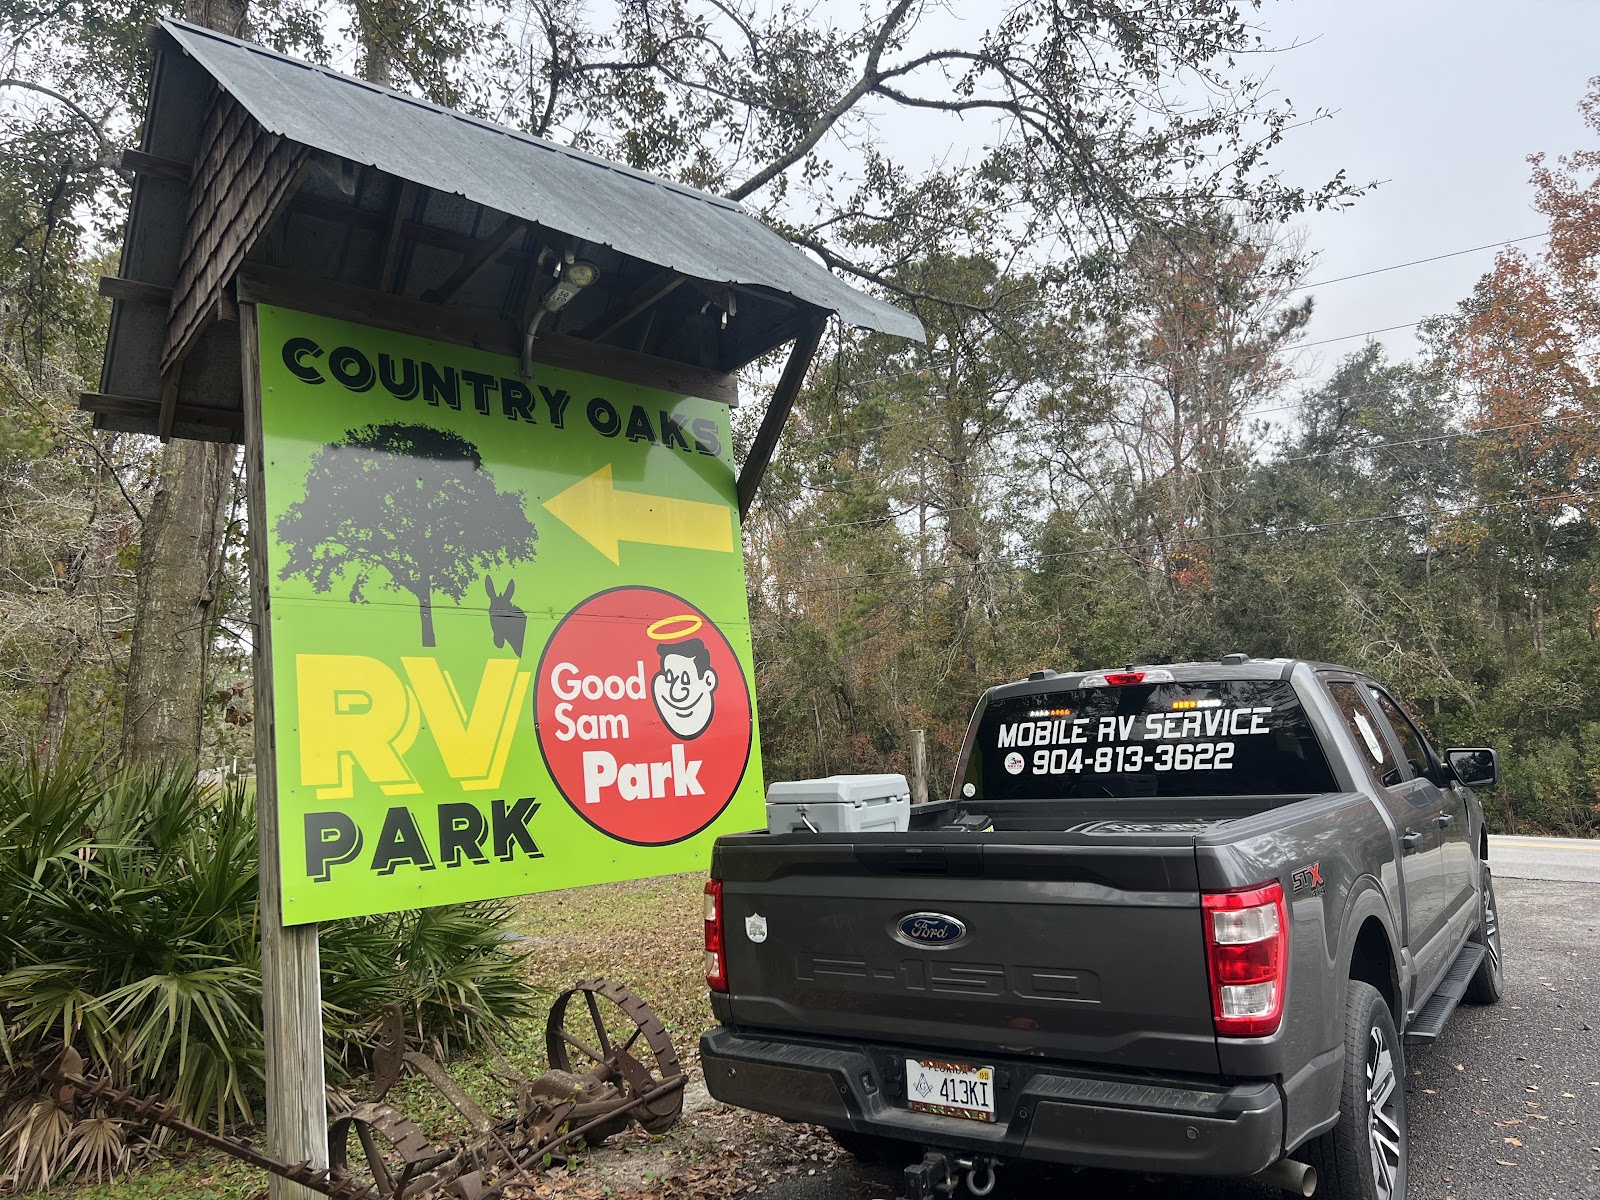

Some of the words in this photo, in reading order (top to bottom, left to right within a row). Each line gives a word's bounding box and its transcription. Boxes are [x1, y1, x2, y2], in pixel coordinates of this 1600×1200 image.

[552, 295, 567, 303] LED
[281, 337, 571, 430] COUNTRY
[586, 397, 723, 457] OAKS
[550, 661, 646, 701] Good
[295, 653, 531, 800] RV
[554, 703, 630, 742] Sam
[997, 718, 1090, 749] MOBILE
[1098, 714, 1136, 743] RV
[1143, 707, 1272, 741] SERVICE
[582, 743, 706, 804] Park
[1032, 742, 1235, 775] 904-813-3622
[303, 797, 545, 884] PARK
[1291, 862, 1324, 893] STX
[911, 919, 949, 939] Ford
[795, 952, 1102, 1005] F-150
[940, 1077, 989, 1107] 413KI
